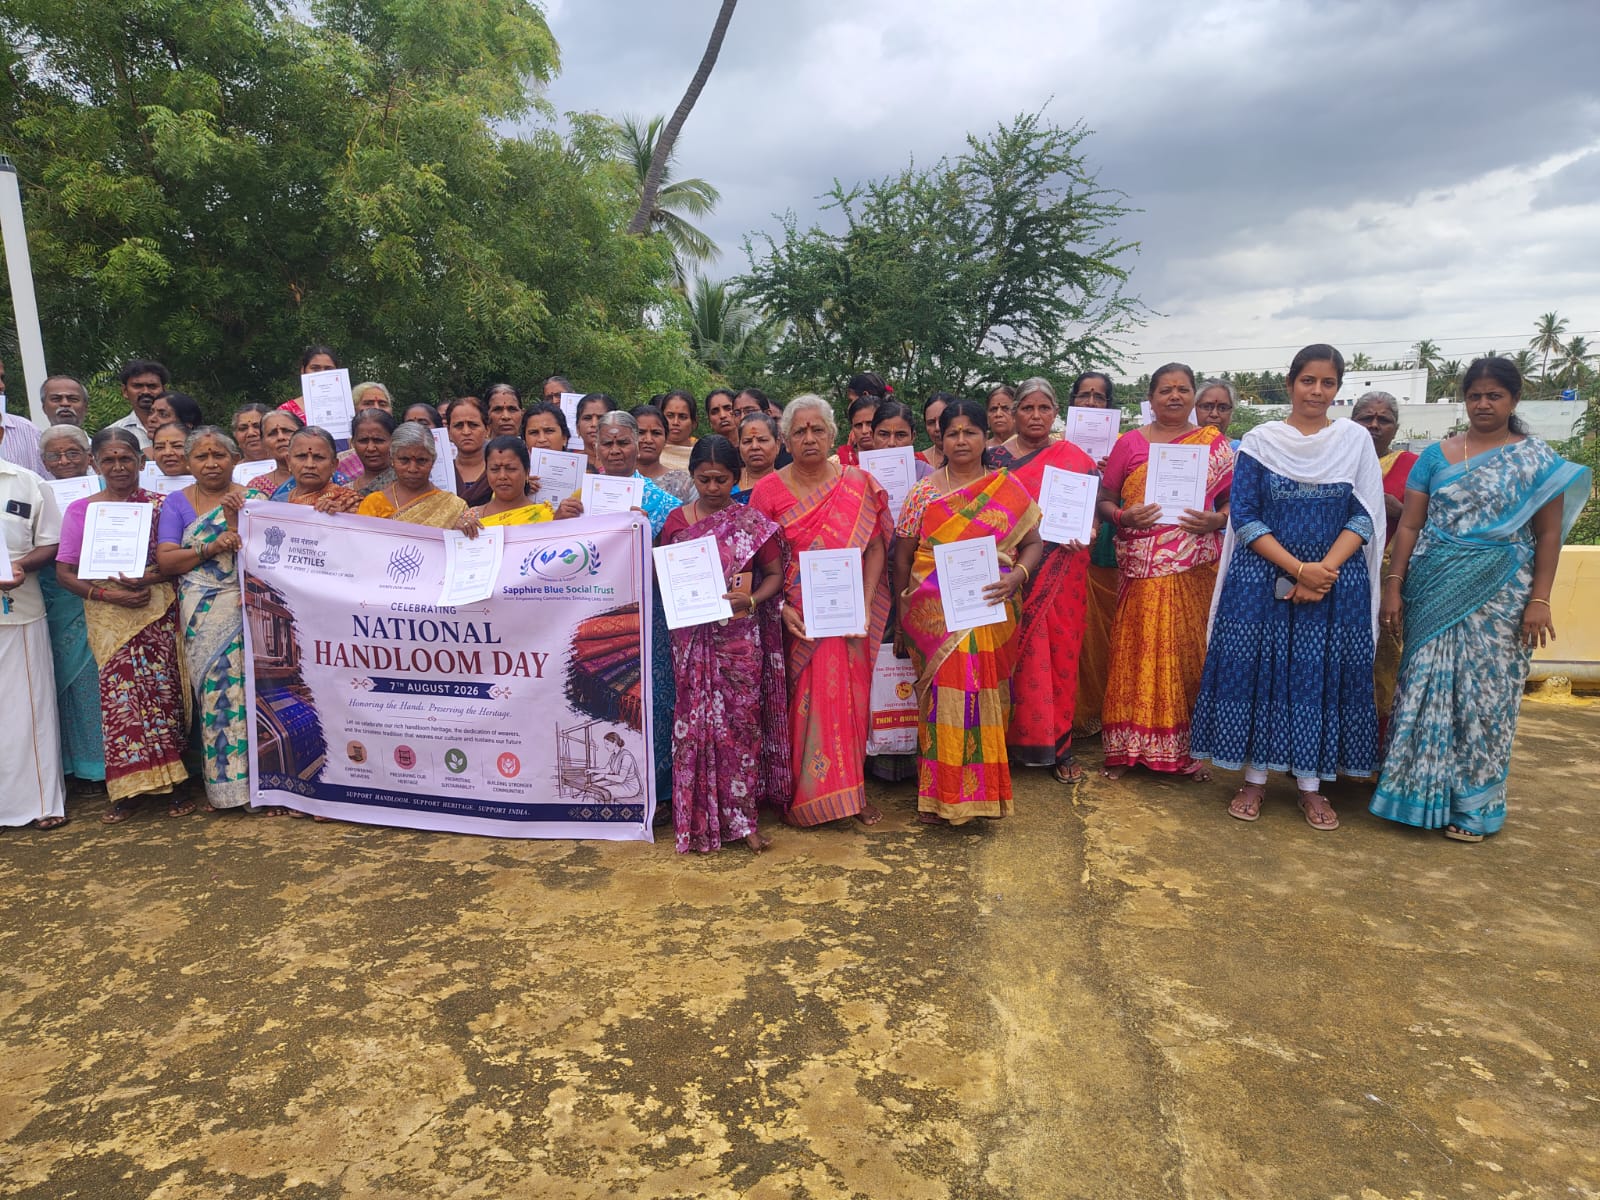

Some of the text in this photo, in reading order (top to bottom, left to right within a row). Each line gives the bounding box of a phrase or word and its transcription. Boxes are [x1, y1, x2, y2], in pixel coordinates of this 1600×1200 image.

[288, 546, 317, 557] MINISTRY
[287, 554, 325, 568] TEXTILES
[503, 585, 614, 595] Sapphire Blue Social Trust
[390, 602, 457, 615] CELEBRATING
[351, 614, 502, 644] NATIONAL
[313, 639, 550, 679] HANDLOOM DAY
[407, 682, 451, 694] AUGUST
[453, 685, 479, 696] 2026
[348, 698, 384, 712] Honoring
[386, 700, 397, 710] the
[428, 703, 464, 717] Preserving
[466, 704, 477, 714] the
[478, 707, 513, 720] Heritage.
[346, 791, 372, 800] SUPPORT
[413, 799, 440, 808] SUPPORT
[478, 806, 507, 814] SUPPORT
[507, 808, 531, 816] INDIA.
